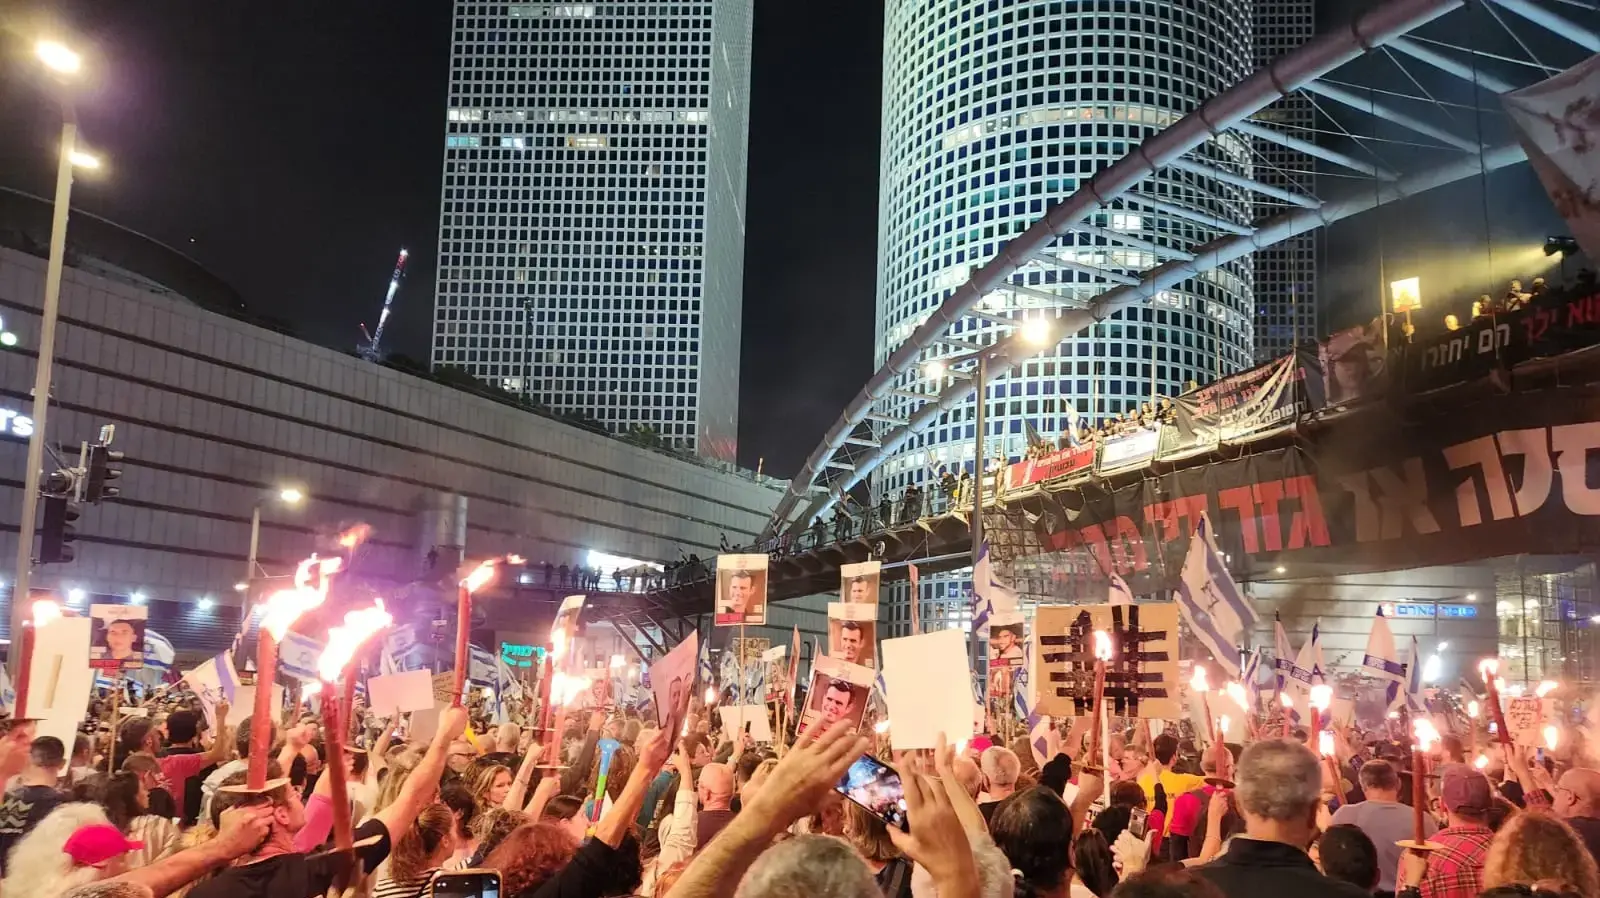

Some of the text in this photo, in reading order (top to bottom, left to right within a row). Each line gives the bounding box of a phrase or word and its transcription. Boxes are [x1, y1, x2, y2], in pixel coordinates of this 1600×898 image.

[1478, 323, 1510, 354] הם
[1218, 474, 1331, 554] גזר
[1338, 457, 1441, 542] או
